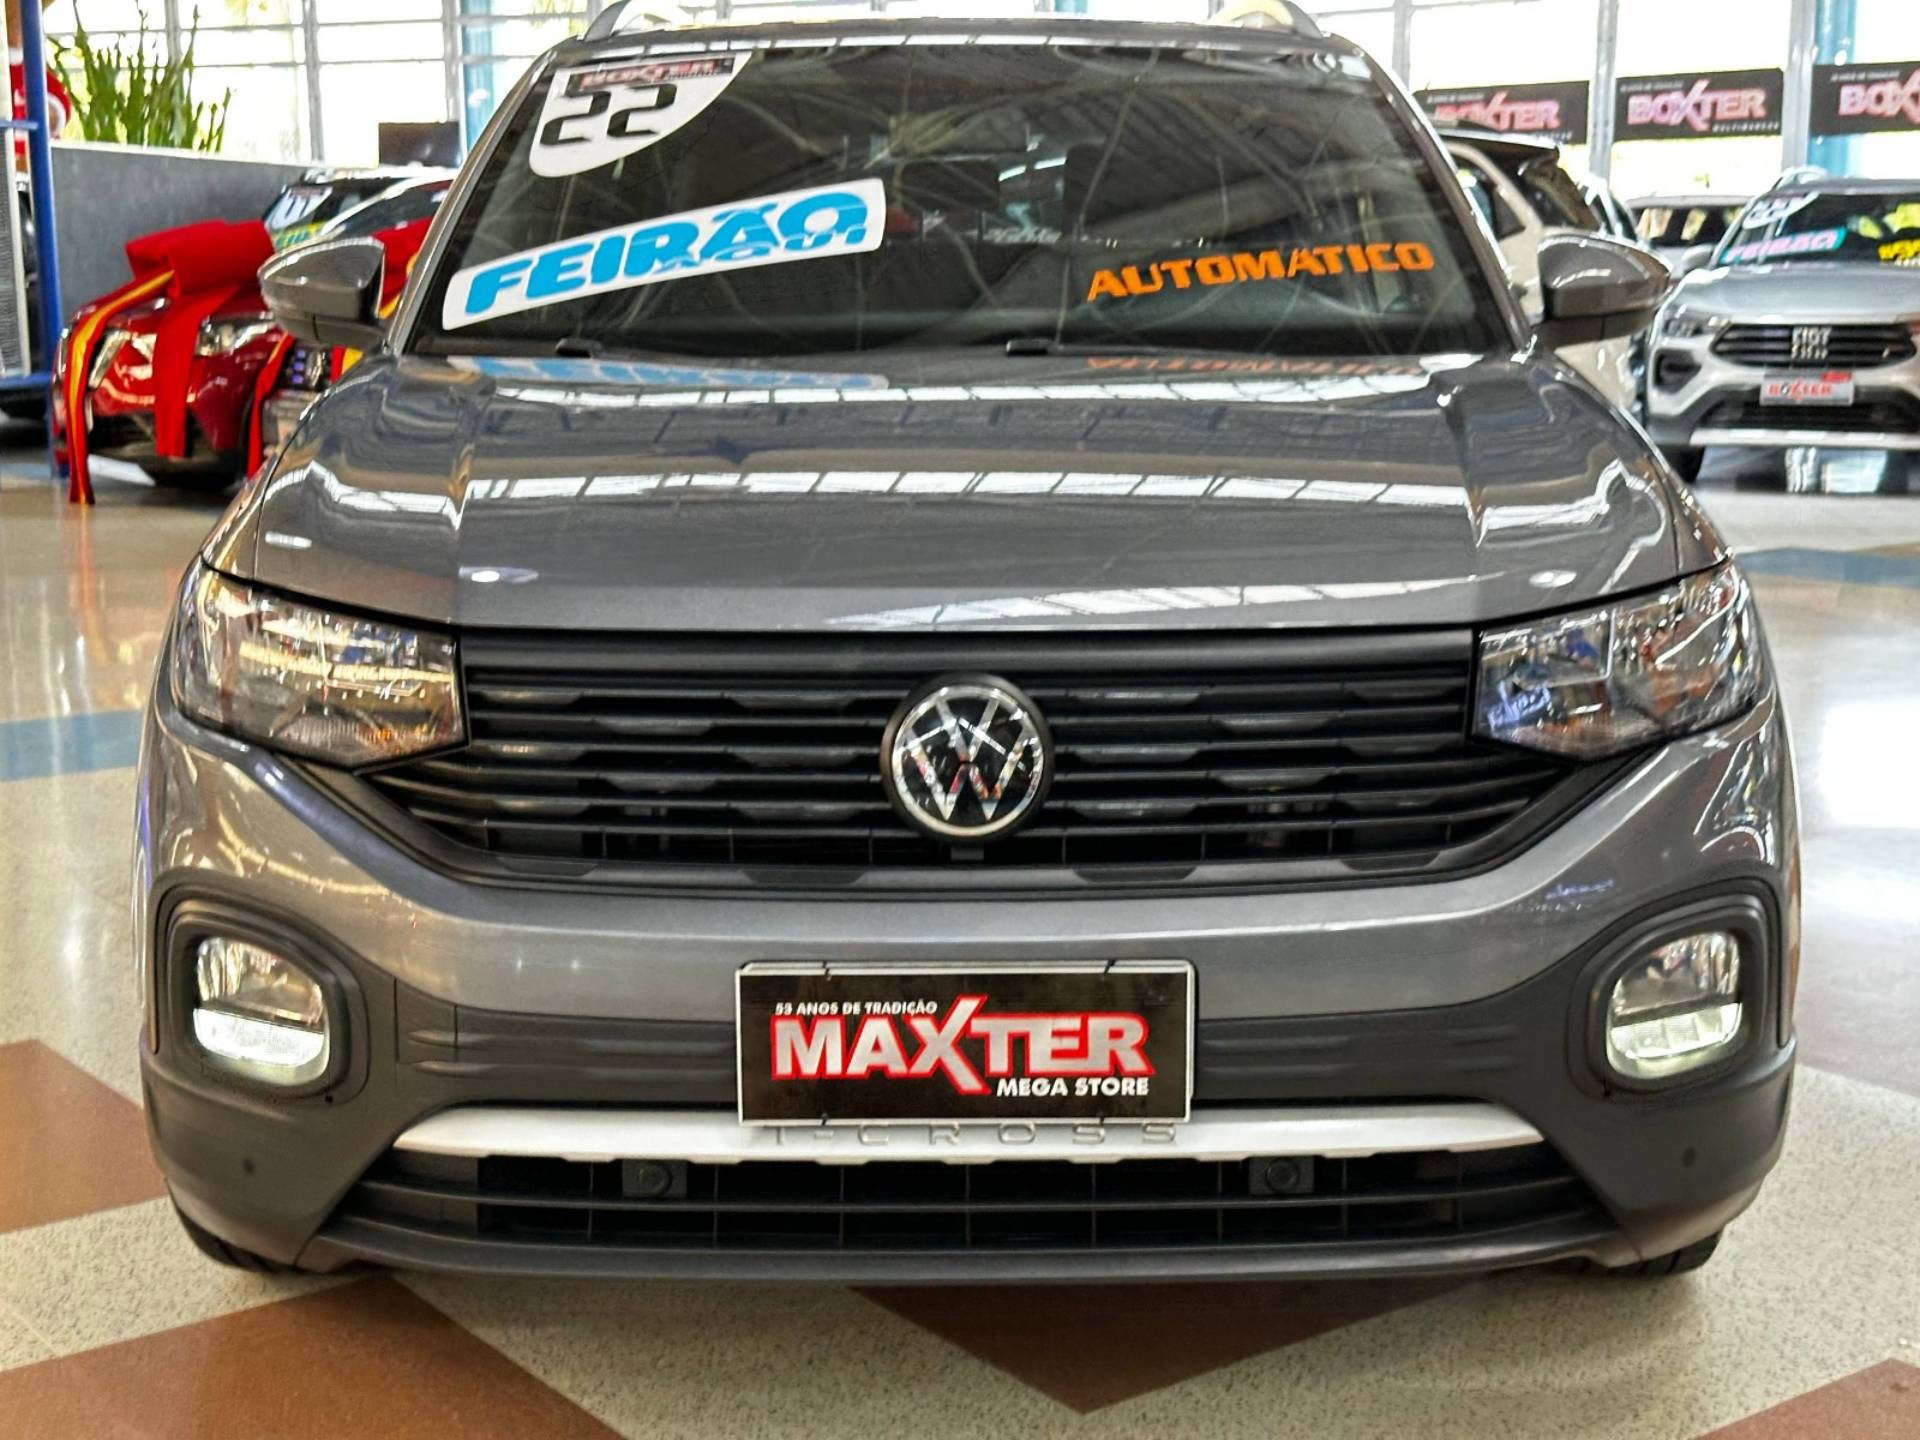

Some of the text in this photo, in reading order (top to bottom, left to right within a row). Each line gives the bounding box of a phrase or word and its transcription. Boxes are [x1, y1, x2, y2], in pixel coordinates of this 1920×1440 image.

[539, 83, 677, 146] 22
[1627, 78, 1767, 132] BOXTER
[463, 191, 868, 315] FEIRÃO
[796, 1002, 839, 1016] ANOS
[842, 1002, 861, 1015] DE
[864, 999, 938, 1016] TRADIÇÃO
[771, 993, 1154, 1095] MAXTER
[996, 1077, 1149, 1097] MEGA STORE
